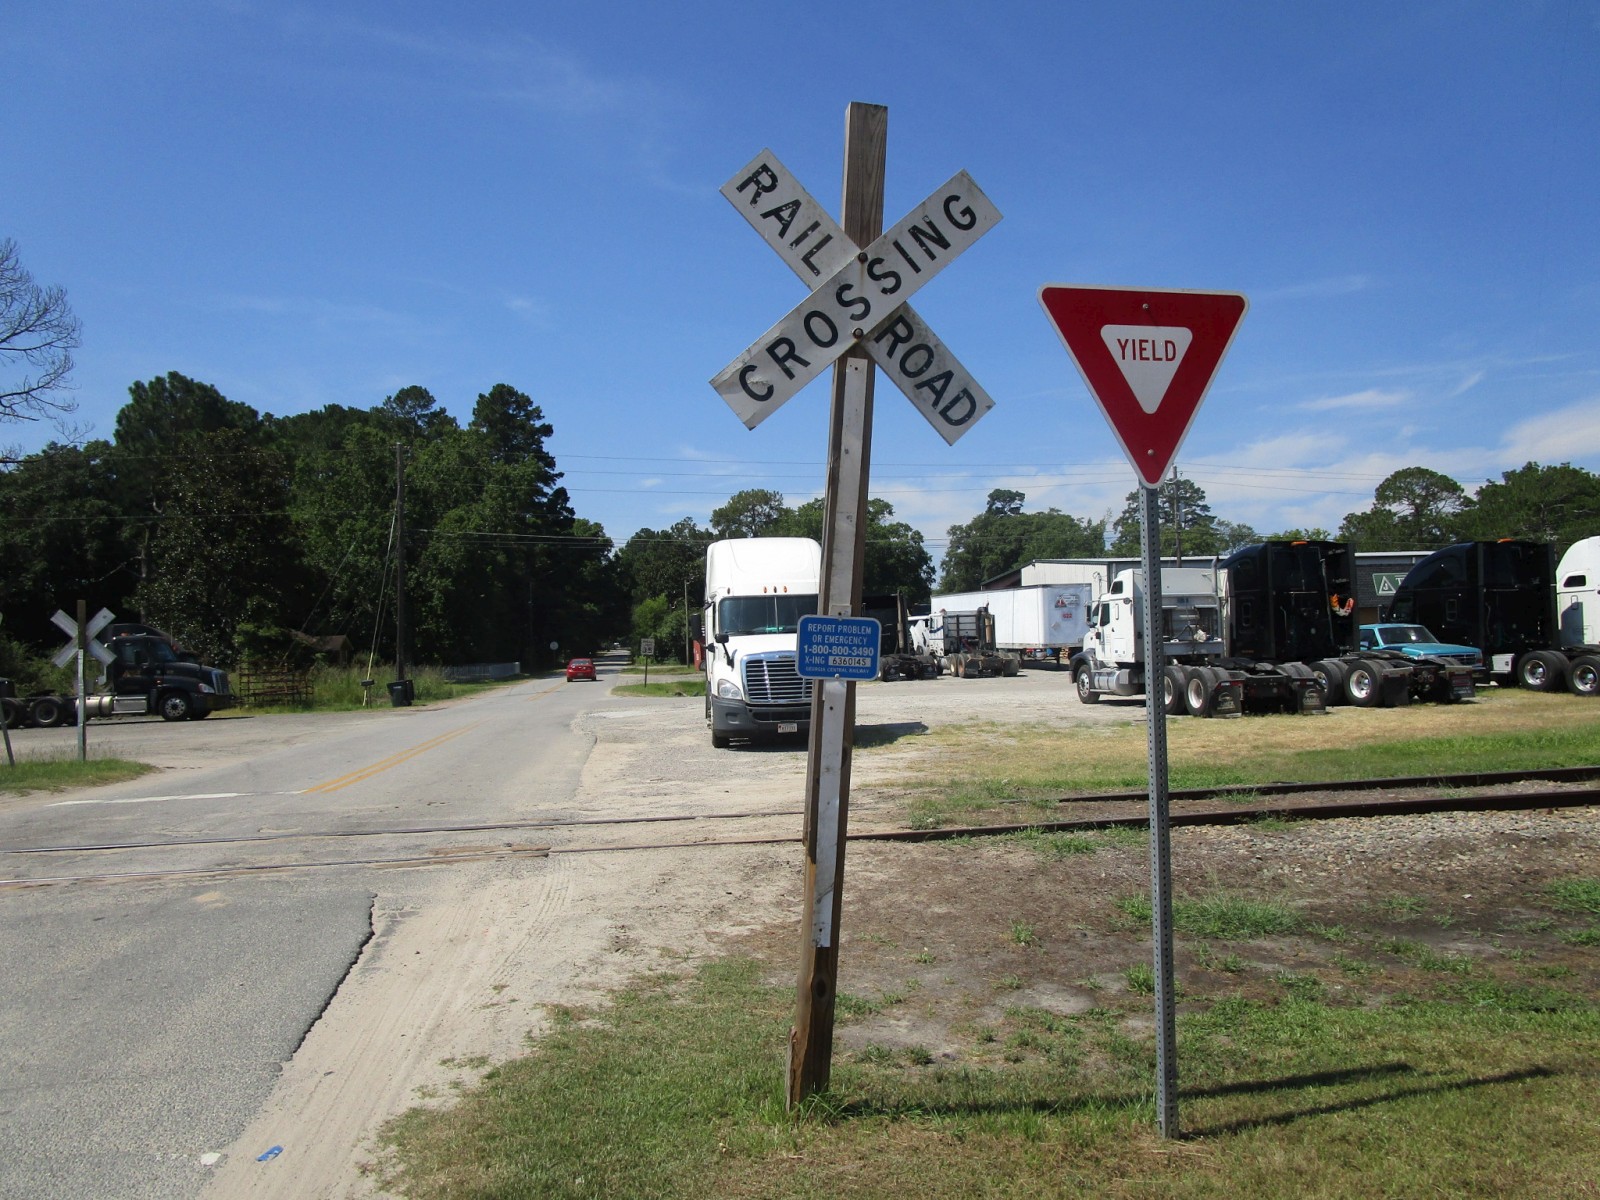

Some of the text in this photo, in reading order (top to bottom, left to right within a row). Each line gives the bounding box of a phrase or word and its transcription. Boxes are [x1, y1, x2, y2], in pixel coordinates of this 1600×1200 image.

[736, 163, 977, 427] RAIL ROAD
[739, 194, 977, 402] CROSSING
[1117, 338, 1176, 362] YIELD
[808, 623, 872, 635] REPORT PROBLEM
[812, 635, 868, 645] OR EMERGENCY
[803, 644, 874, 656] 1-800-800-3490
[805, 656, 825, 664] X-ING
